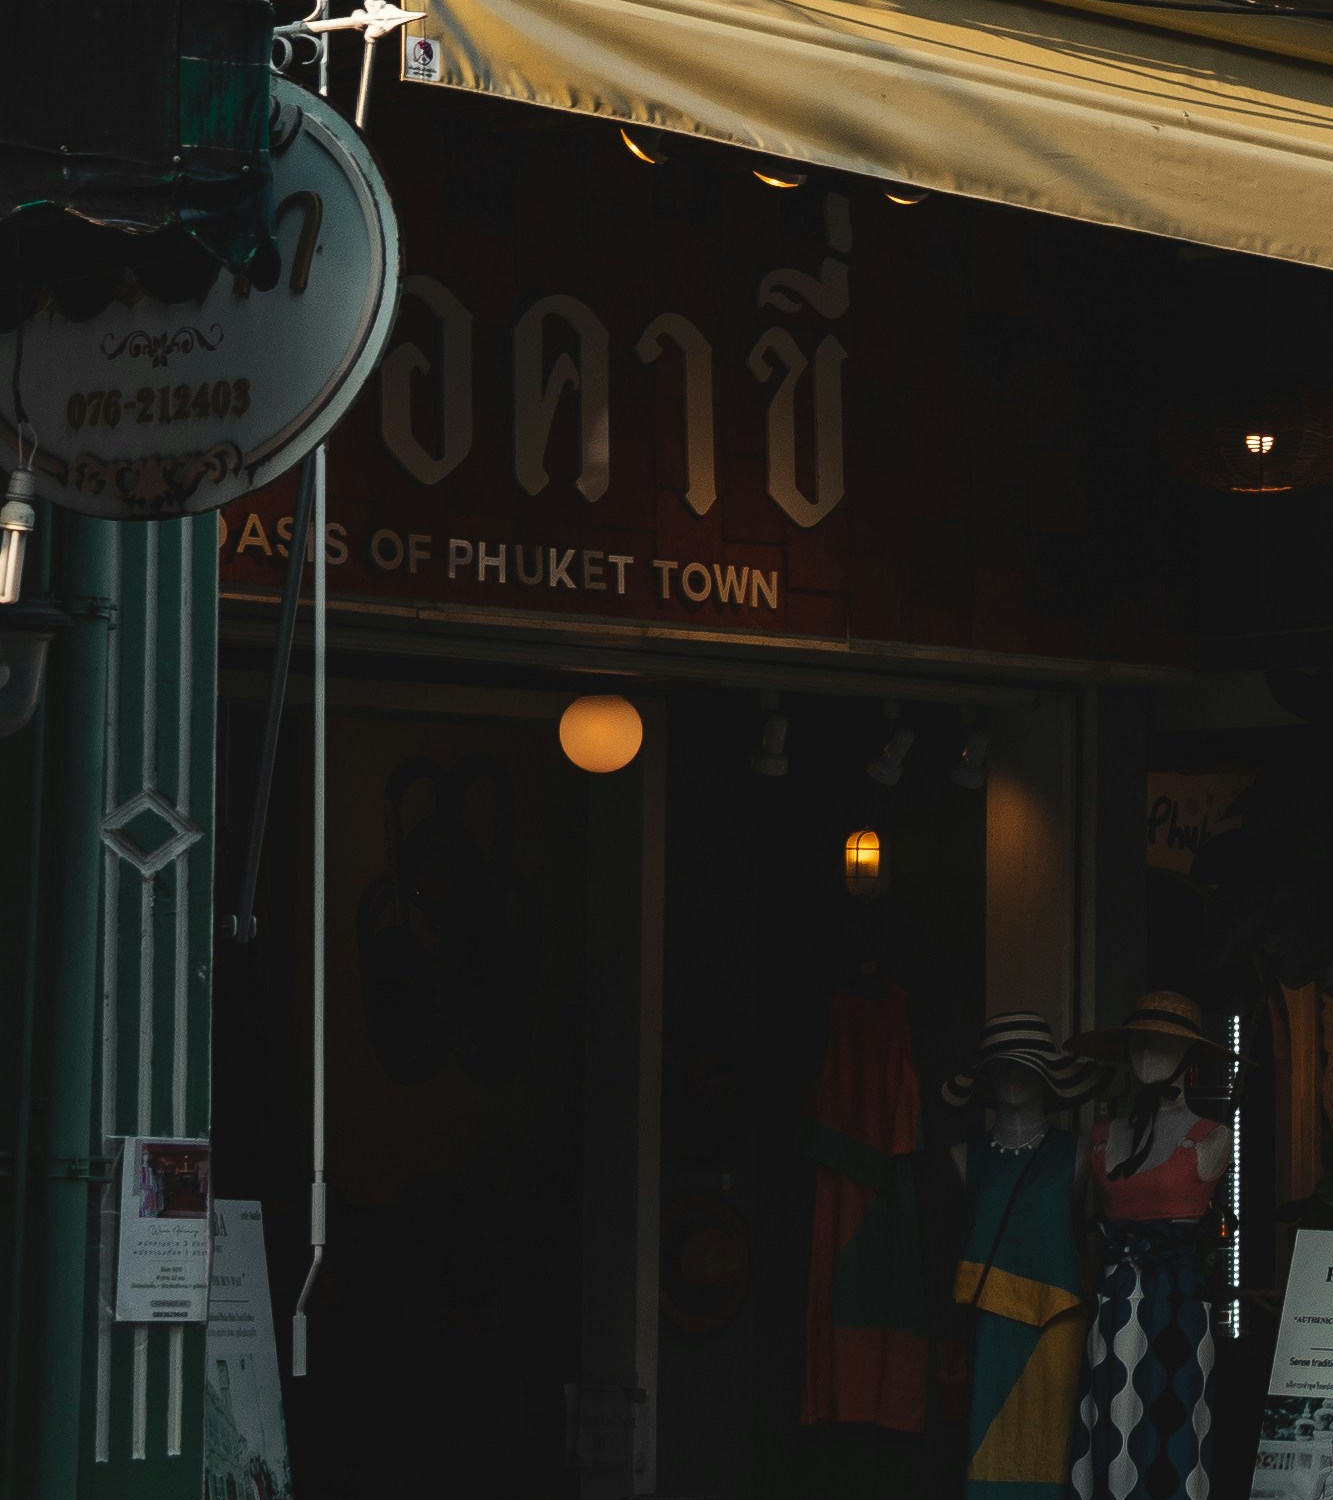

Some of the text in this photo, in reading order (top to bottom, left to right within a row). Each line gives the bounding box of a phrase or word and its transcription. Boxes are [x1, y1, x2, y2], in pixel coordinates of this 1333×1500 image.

[66, 379, 252, 430] 076-212403
[219, 513, 779, 610] ASIS OF PHUKET TOWN
